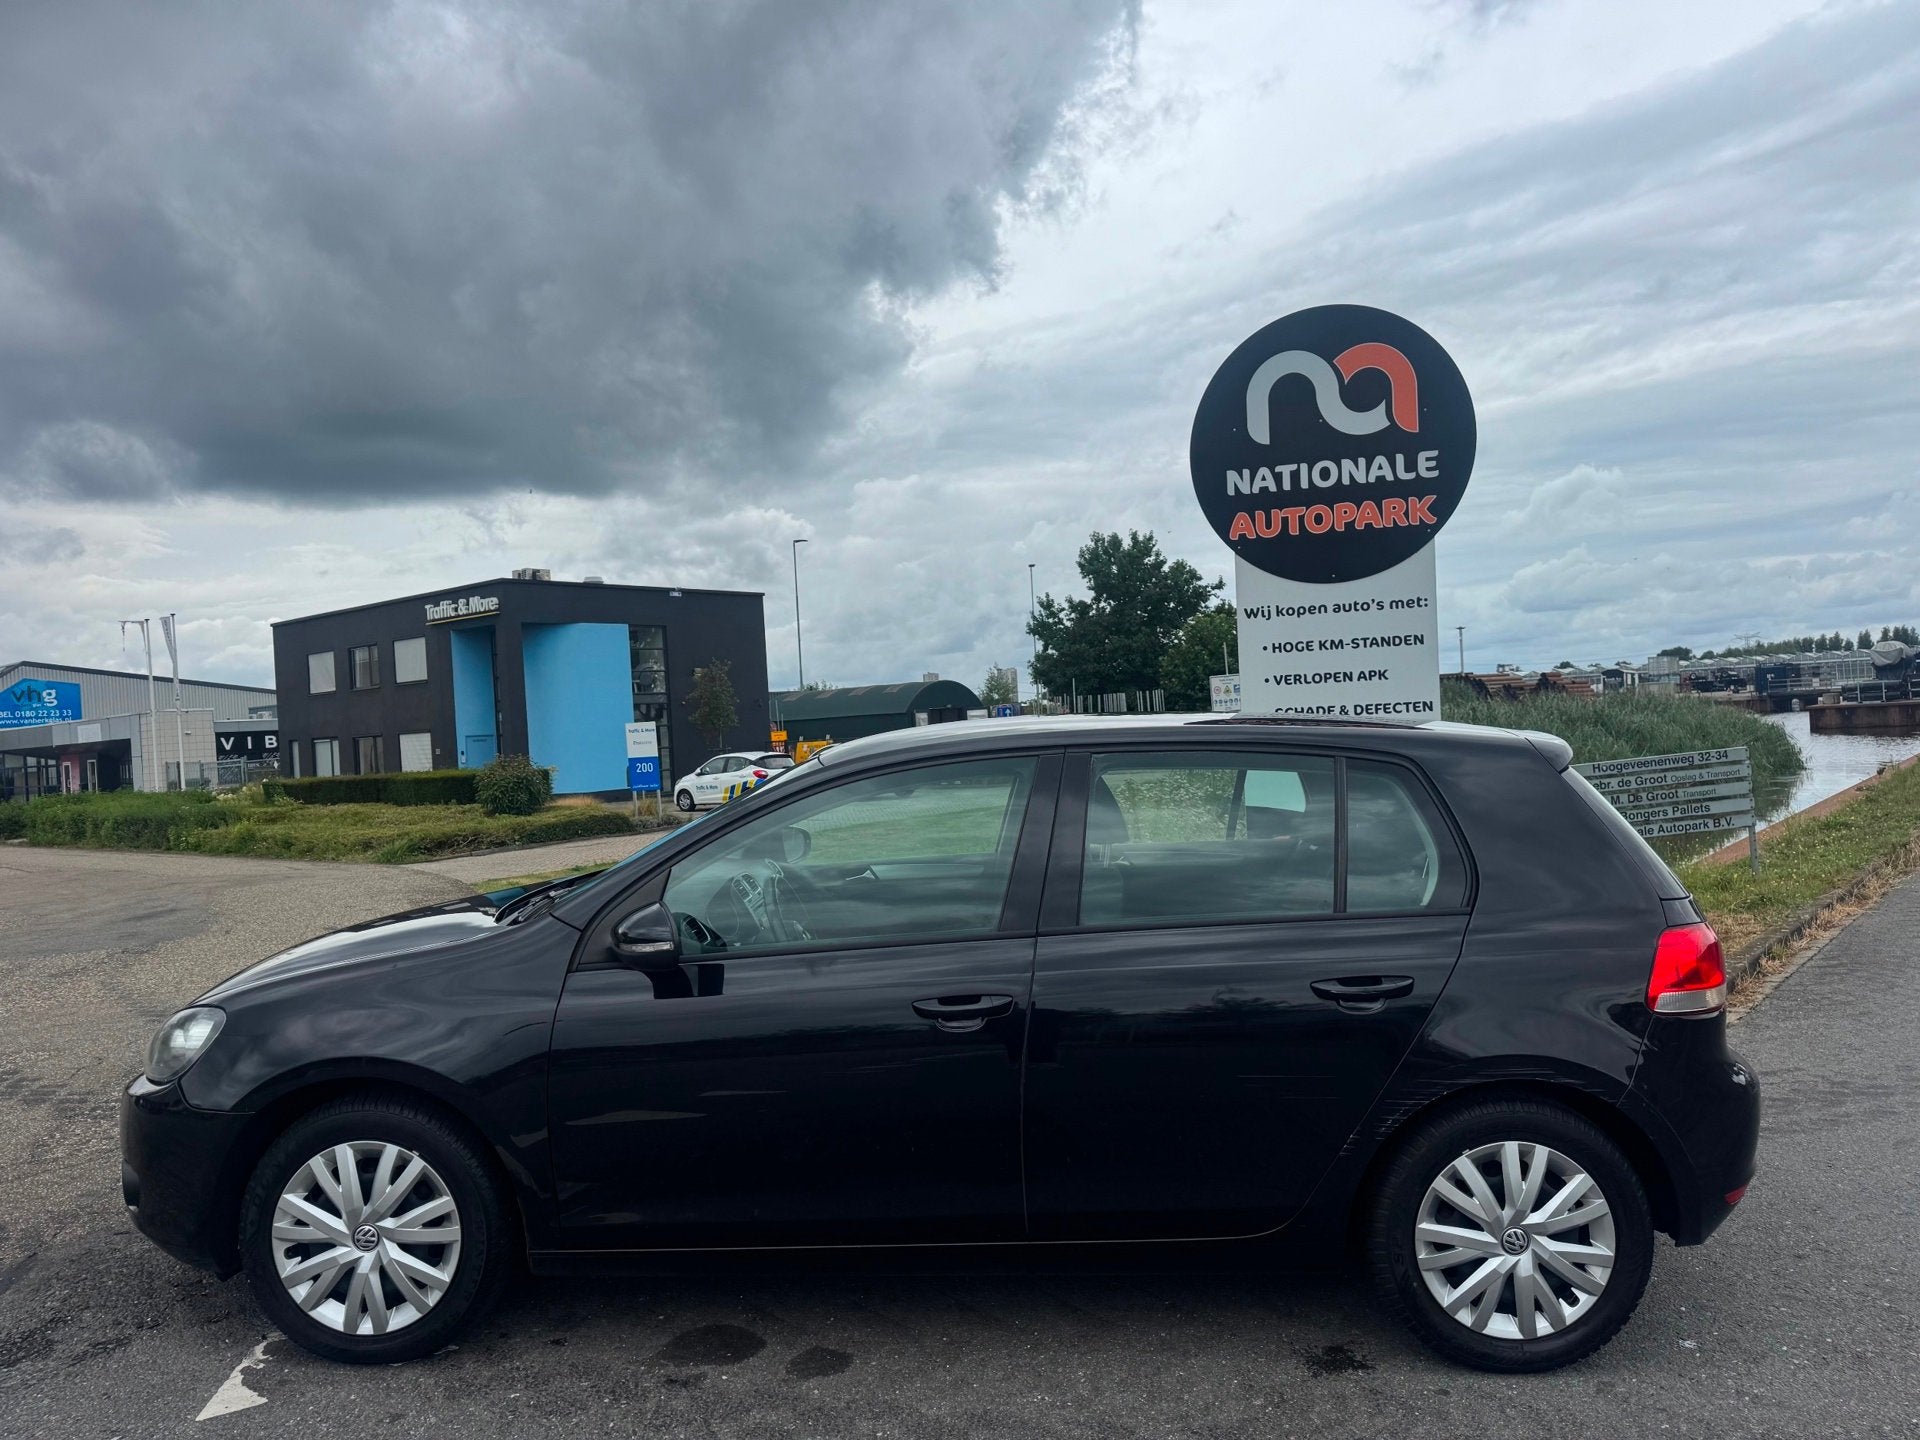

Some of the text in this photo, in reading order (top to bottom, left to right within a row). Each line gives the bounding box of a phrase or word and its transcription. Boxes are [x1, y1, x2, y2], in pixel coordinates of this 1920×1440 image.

[1226, 449, 1440, 496] NATIONALE
[1229, 494, 1438, 541] AUTOPARK
[424, 595, 499, 621] Traffic & More
[1243, 605, 1272, 621] Wij
[1275, 603, 1328, 618] kopen
[1389, 596, 1429, 610] met:
[1271, 633, 1425, 654] HOGE KM-STANDEN
[1273, 668, 1389, 686] VERLOPEN APK
[11, 685, 58, 707] vhg
[0, 710, 14, 718] BEL
[15, 710, 36, 718] 0180
[38, 709, 48, 717] 22
[50, 709, 60, 717] 23
[1339, 704, 1350, 716] &
[1353, 700, 1434, 716] DEFECTEN
[635, 762, 654, 773] 200
[1592, 750, 1729, 773] Hoogeveenenweg 32-34
[1592, 780, 1614, 790] ebr.
[1617, 778, 1632, 788] de
[1635, 774, 1668, 786] Groot
[1671, 773, 1697, 783] Opslag
[1706, 768, 1741, 778] Transport
[1610, 787, 1717, 805] M. De Groot Transport
[1620, 803, 1711, 821] Bongers Pallets
[1657, 820, 1710, 834] Autopark
[1713, 816, 1735, 828] B.V.
